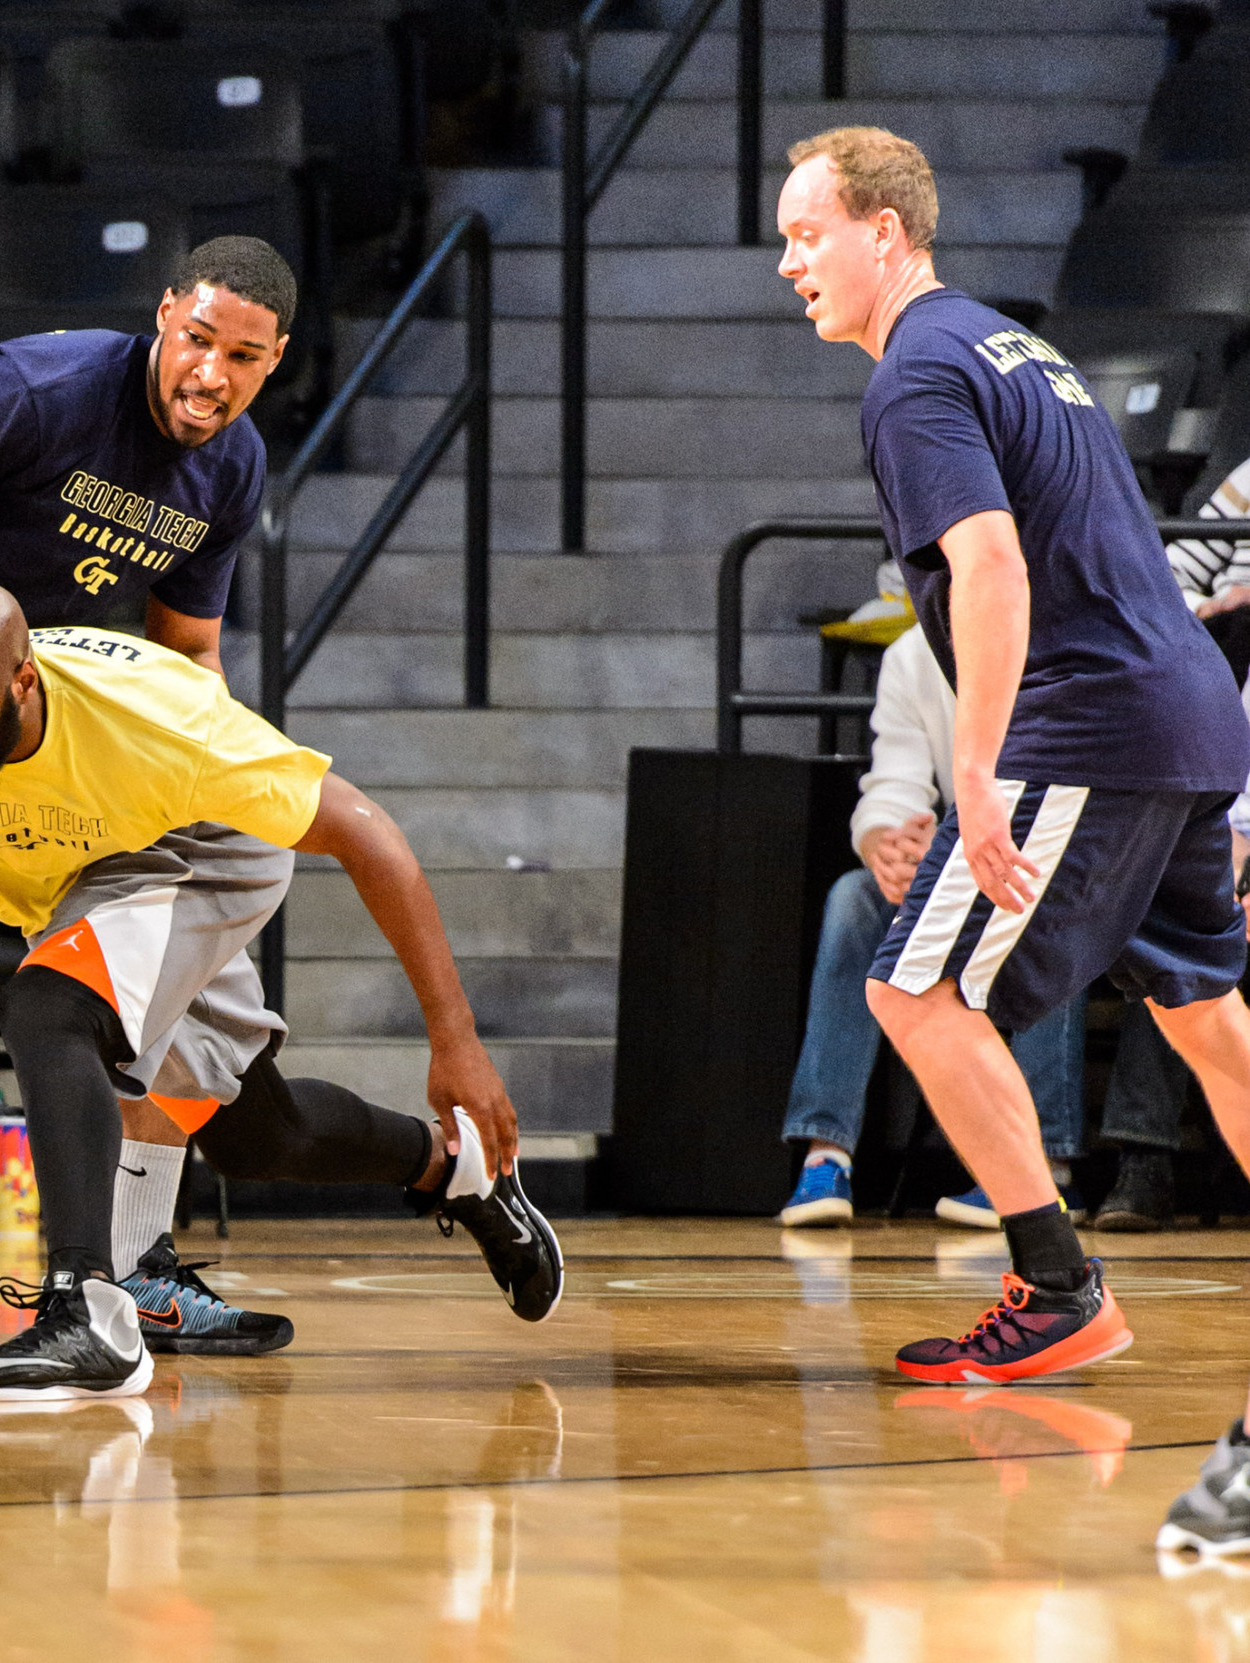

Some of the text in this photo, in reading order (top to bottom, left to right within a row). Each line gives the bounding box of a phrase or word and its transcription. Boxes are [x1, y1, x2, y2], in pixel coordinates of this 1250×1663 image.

[61, 470, 210, 553] GEORGIA TECH
[59, 513, 175, 572] Basketball
[73, 556, 119, 596] GT
[38, 804, 109, 839] TECH
